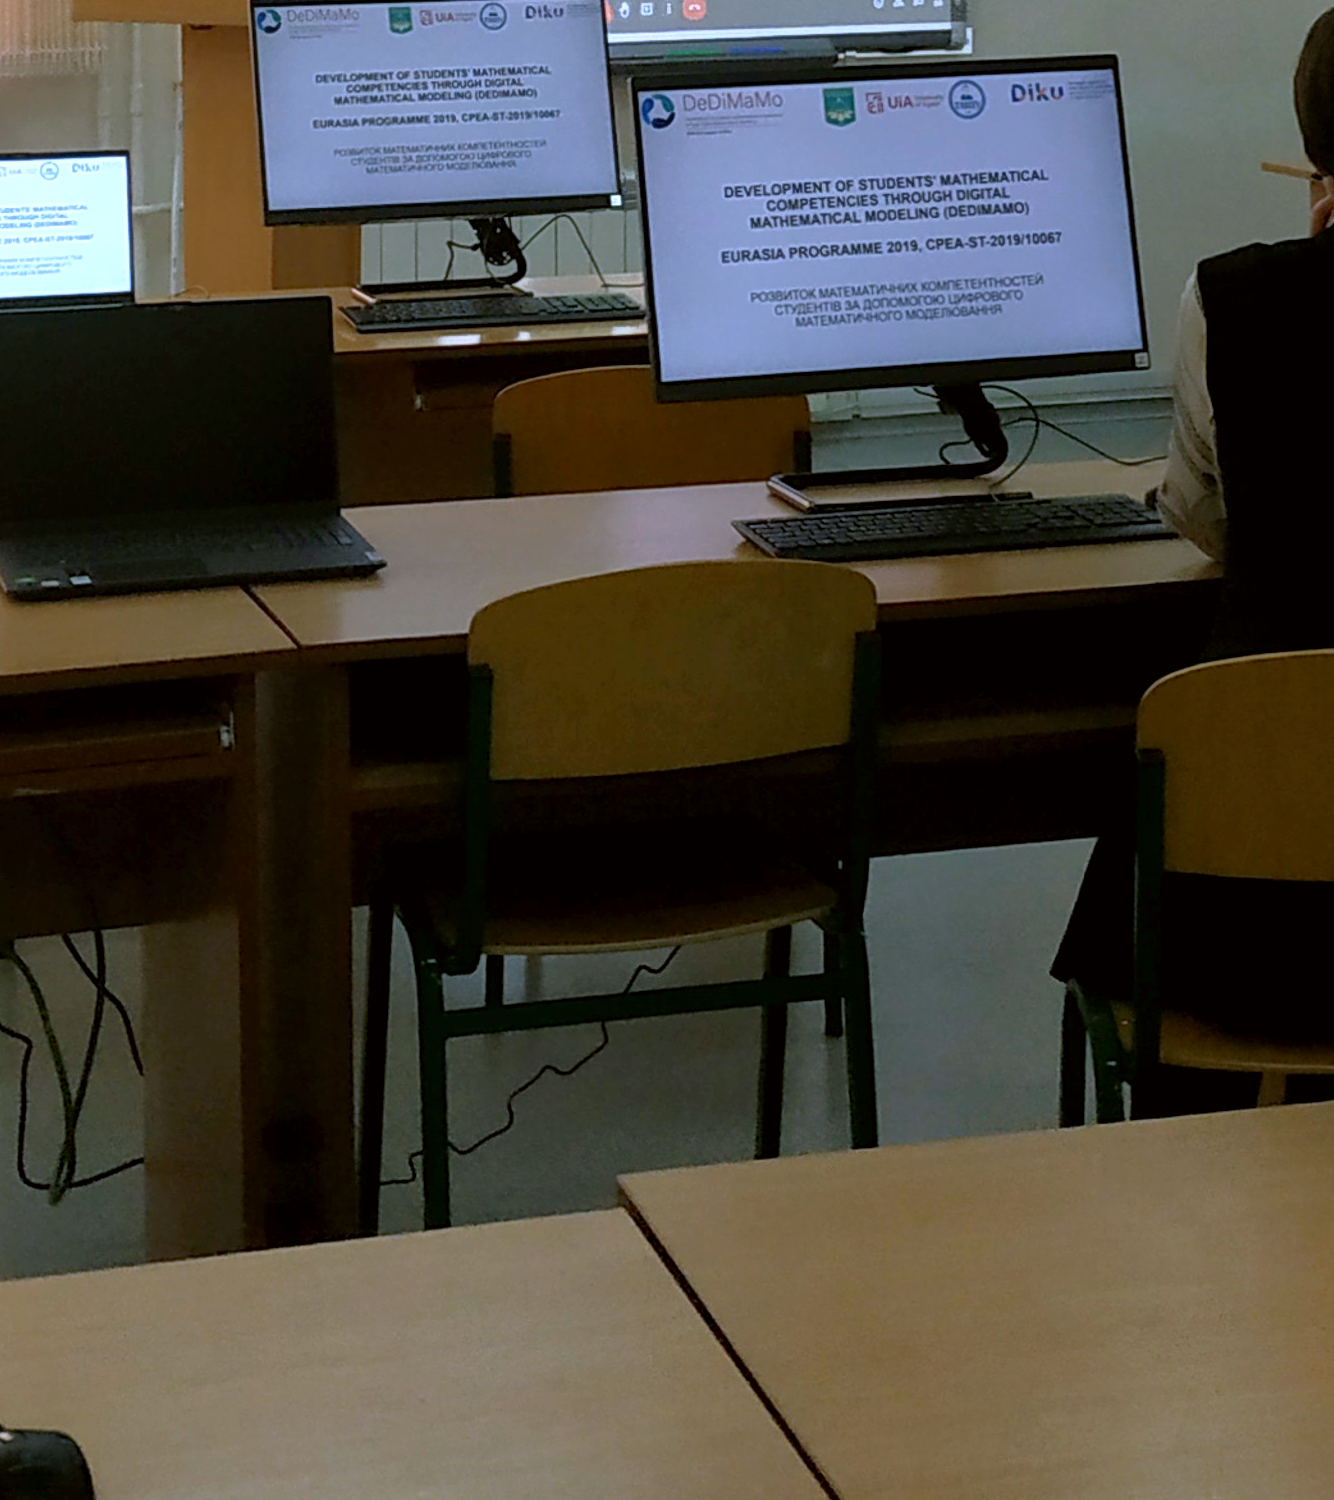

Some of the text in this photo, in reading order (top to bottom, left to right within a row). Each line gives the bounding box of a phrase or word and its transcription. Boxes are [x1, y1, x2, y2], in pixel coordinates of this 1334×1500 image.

[287, 8, 359, 22] DeDiMaMo
[525, 4, 563, 20] Diku
[315, 65, 551, 84] DEVELOPMENT OF STUDENTS' MATHEMATICAL
[333, 88, 537, 106] MATHEMATICAL MODELING (DEDIMAMO)
[345, 78, 523, 94] COMPETENCIES THROUGH DIGITAL
[1011, 82, 1064, 102] Diku
[682, 90, 784, 112] DeDiMaMo
[312, 118, 359, 130] EURASIA
[361, 115, 431, 127] PROGRAMME
[723, 169, 1049, 198] DEVELOPMENT OF STUDENTS' MATHEMATICAL
[765, 187, 1011, 212] COMPETENCIES THROUGH DIGITAL
[749, 202, 1030, 230] MATHEMATICAL MODELING (DEDIMAMO)
[721, 232, 1063, 264] EURASIA PROGRAMME 2019, CPEA-ST-2019/10067
[749, 272, 1045, 304] РОЗВИТОК МАТЕМАТИЧНИХ КОМПЕТЕНТНОСТЕЙ
[774, 289, 1024, 317] СТУДЕНТІВ ЗА ДОПОМОГОЮ ЦИФРОВОГО
[795, 304, 1003, 328] МАТЕМАТИЧНОГО МОДЕЛЮВАННЯ
